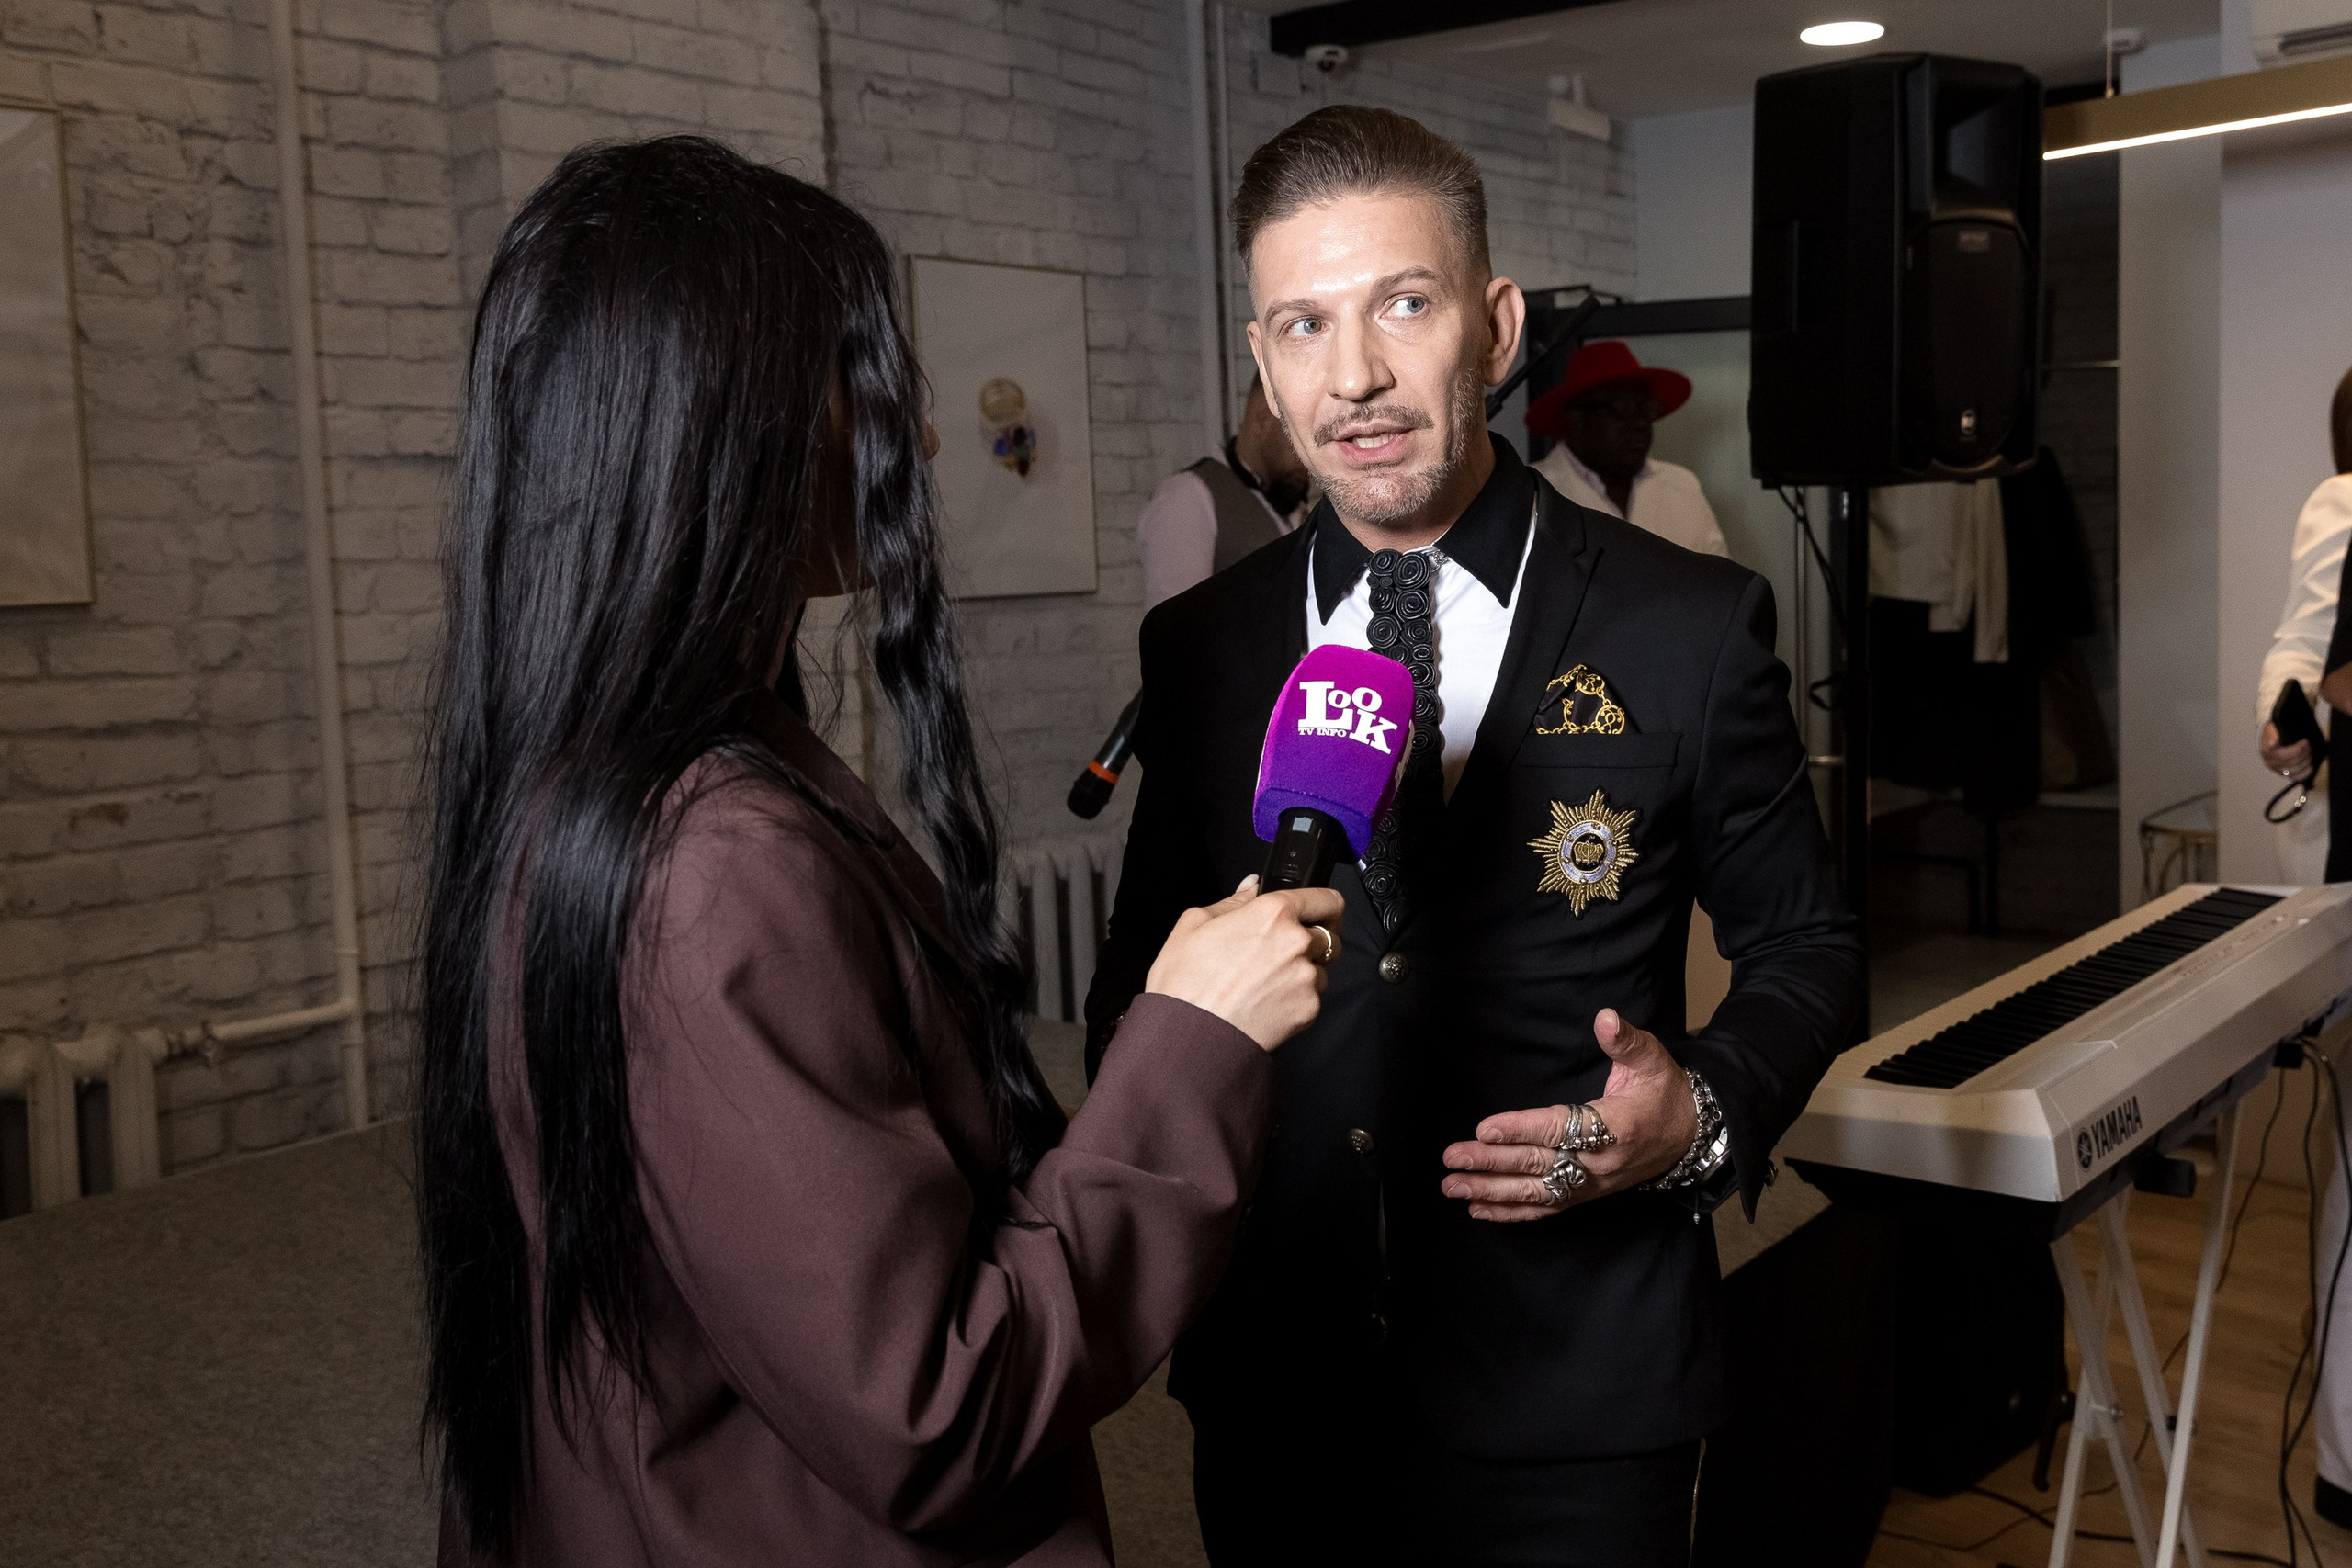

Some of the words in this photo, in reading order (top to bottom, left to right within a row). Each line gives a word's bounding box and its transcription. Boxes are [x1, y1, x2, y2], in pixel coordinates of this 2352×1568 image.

[1298, 728, 1314, 736] TV
[1317, 728, 1347, 738] INFO
[2090, 1095, 2143, 1159] YAMAHA
